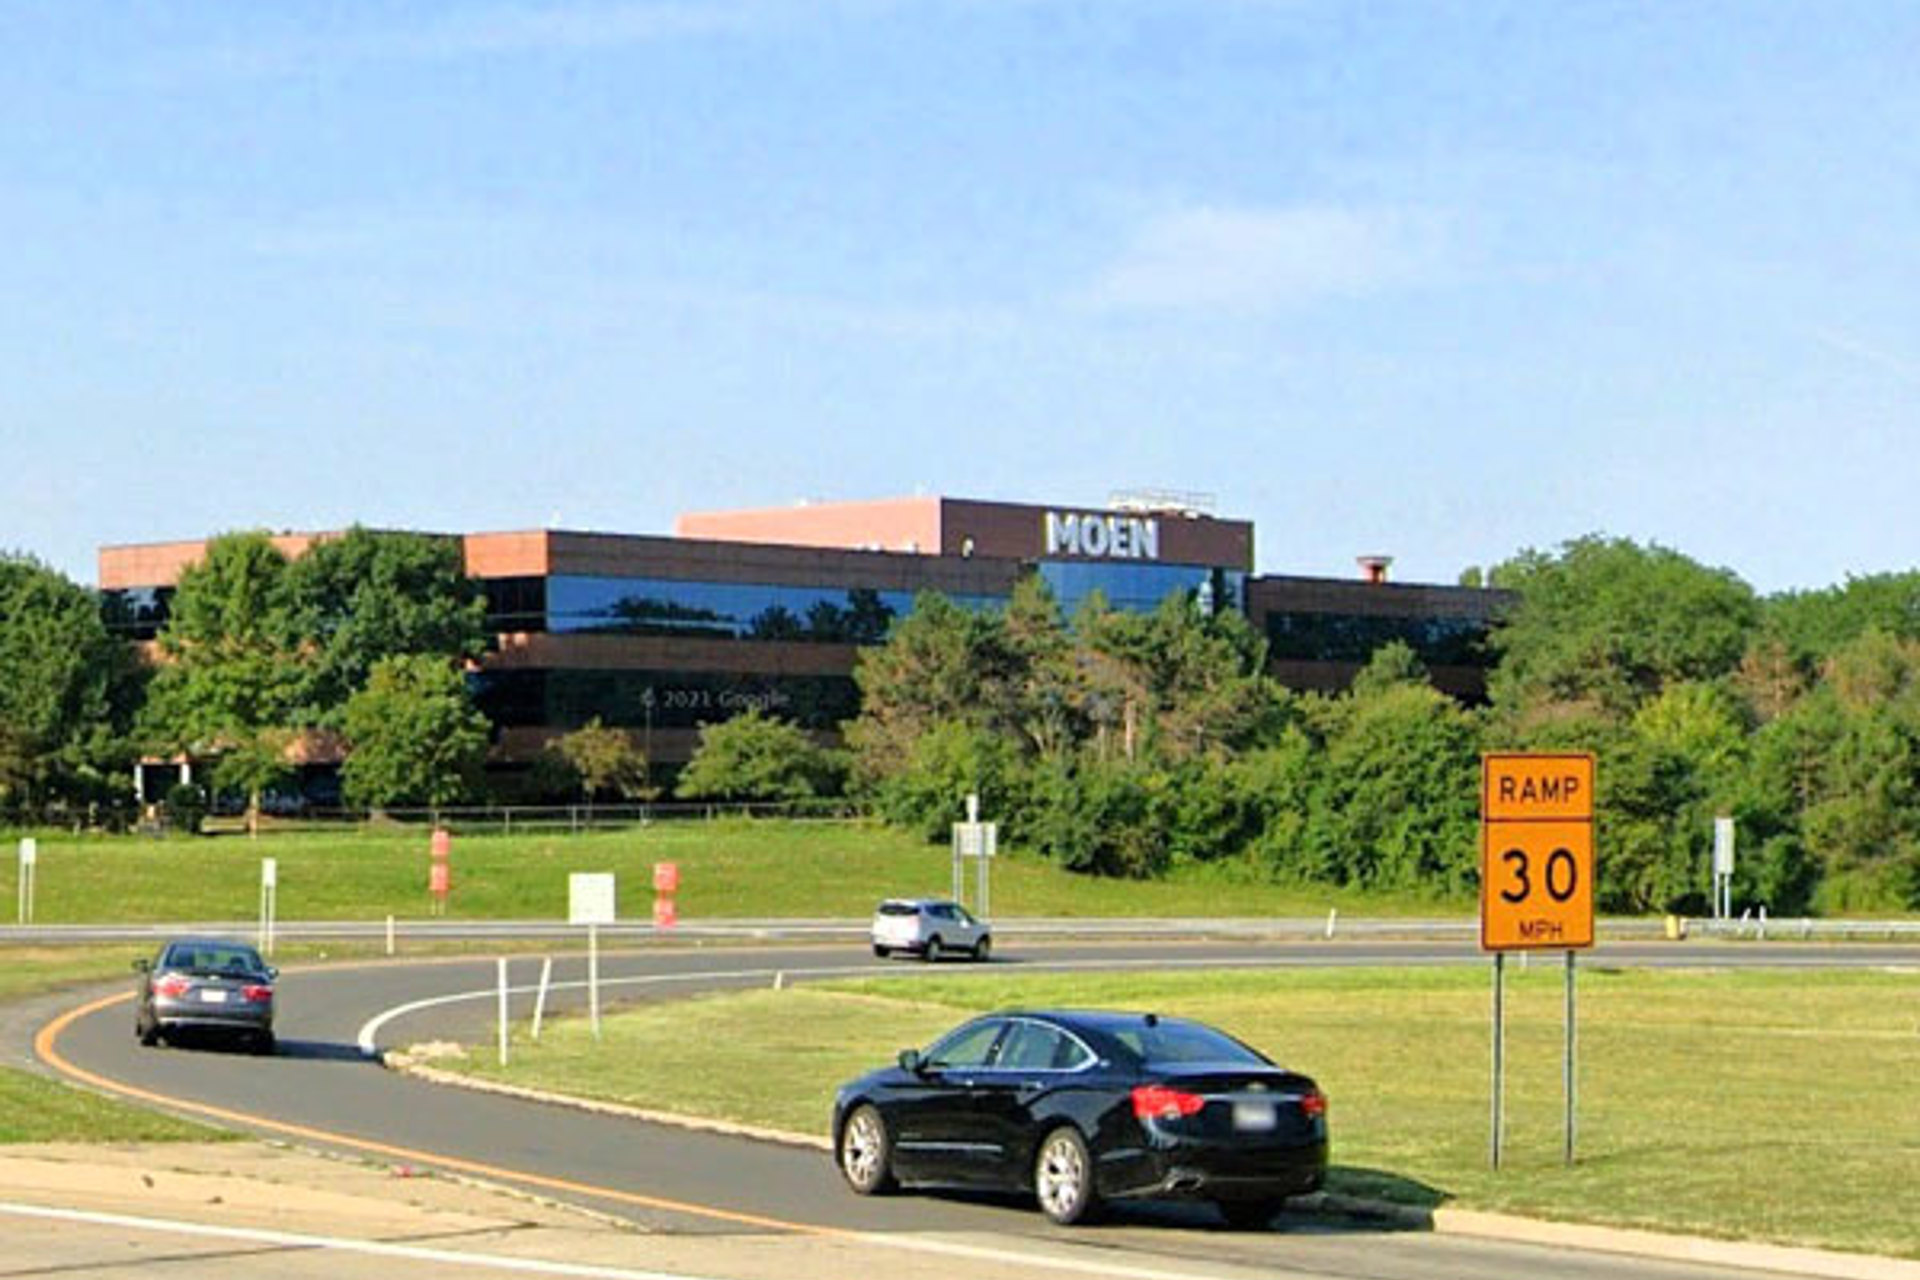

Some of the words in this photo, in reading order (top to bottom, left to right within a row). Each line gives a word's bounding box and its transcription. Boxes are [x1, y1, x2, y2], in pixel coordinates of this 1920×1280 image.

[1045, 511, 1159, 558] MOEN
[1500, 776, 1579, 803] RAMP
[1501, 848, 1577, 903] 30
[1519, 920, 1563, 938] MPH
